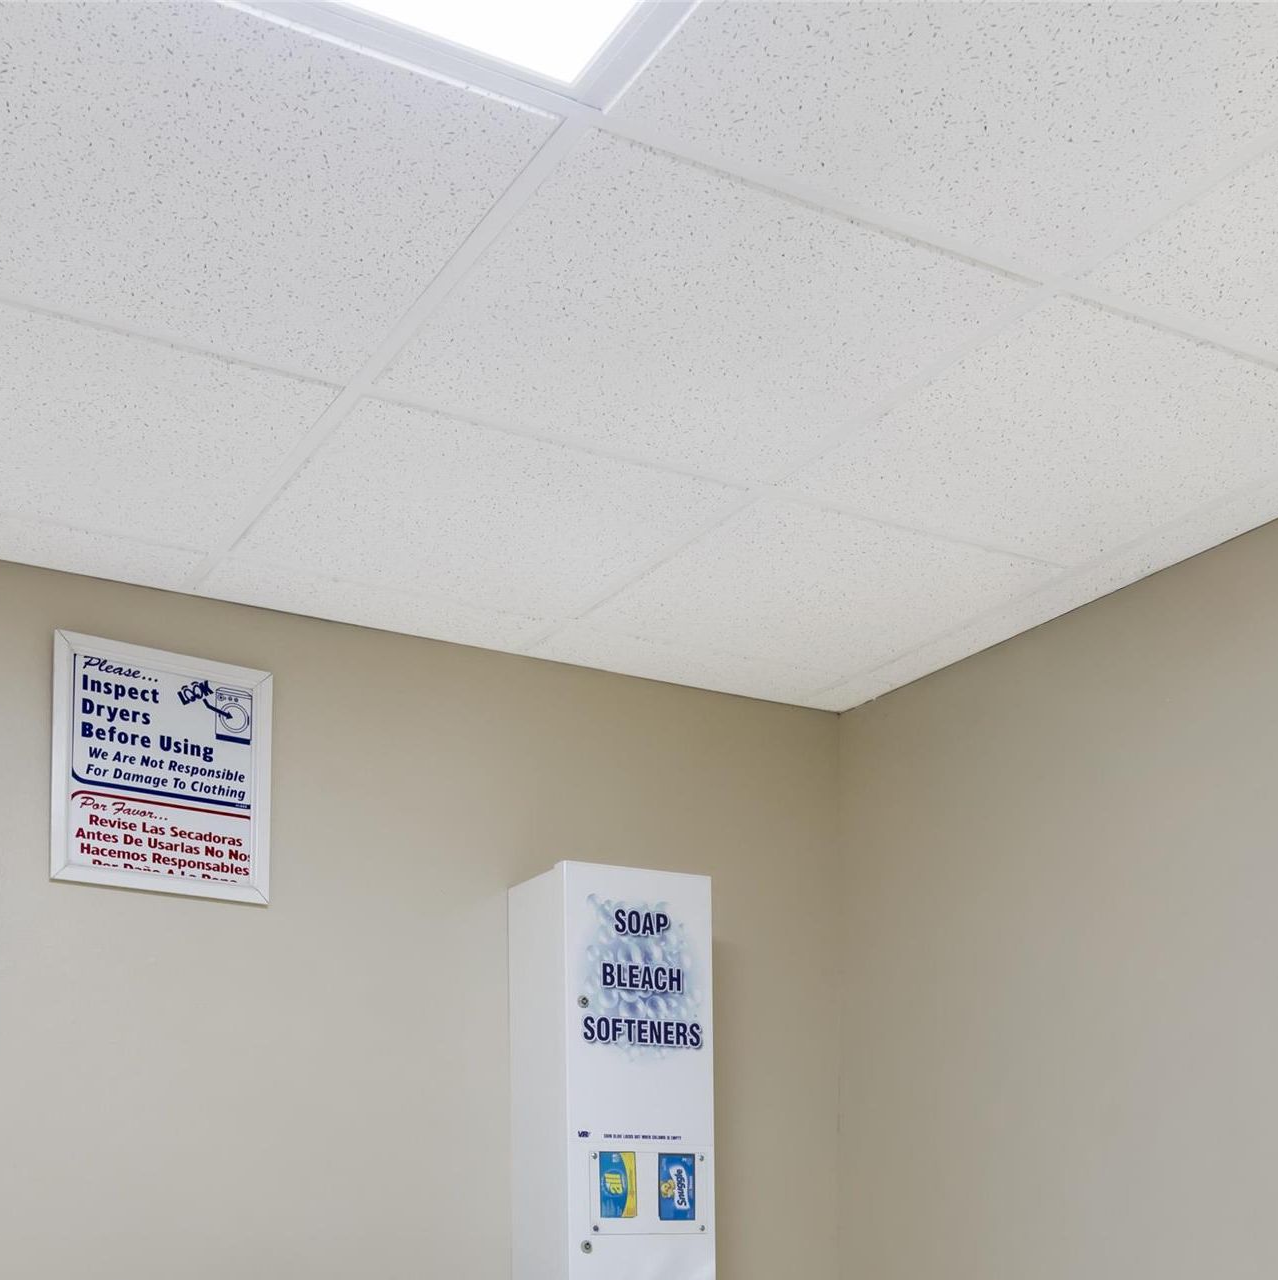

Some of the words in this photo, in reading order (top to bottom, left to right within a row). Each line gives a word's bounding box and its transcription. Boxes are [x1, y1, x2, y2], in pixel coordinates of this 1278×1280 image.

[83, 655, 158, 682] Please...
[82, 674, 159, 704] Inspect
[177, 680, 214, 706] LOOK
[81, 698, 151, 725] Dryers
[81, 721, 151, 748] Before
[159, 735, 214, 763] Using
[88, 746, 109, 760] We
[112, 751, 136, 765] Are
[140, 755, 165, 770] Not
[168, 760, 245, 783] Responsible
[86, 764, 109, 778] For
[113, 768, 169, 788] Damage
[173, 778, 186, 790] To
[191, 781, 246, 801] Clothing
[79, 796, 108, 811] Por
[112, 801, 168, 821] Favor...
[75, 827, 119, 844] Antes
[123, 833, 143, 847] De
[147, 838, 200, 855] Usarlas
[204, 845, 224, 859] No
[88, 814, 137, 832] Revise
[141, 821, 166, 836] Las
[170, 826, 243, 848] Secadoras
[79, 842, 148, 863] Hacemos
[151, 852, 250, 877] Responsables
[614, 908, 669, 936] SOAP
[601, 962, 682, 992] BLEACH
[582, 1015, 702, 1047] SOFTENERS
[603, 1173, 623, 1195] all
[676, 1168, 687, 1207] Snuggle
